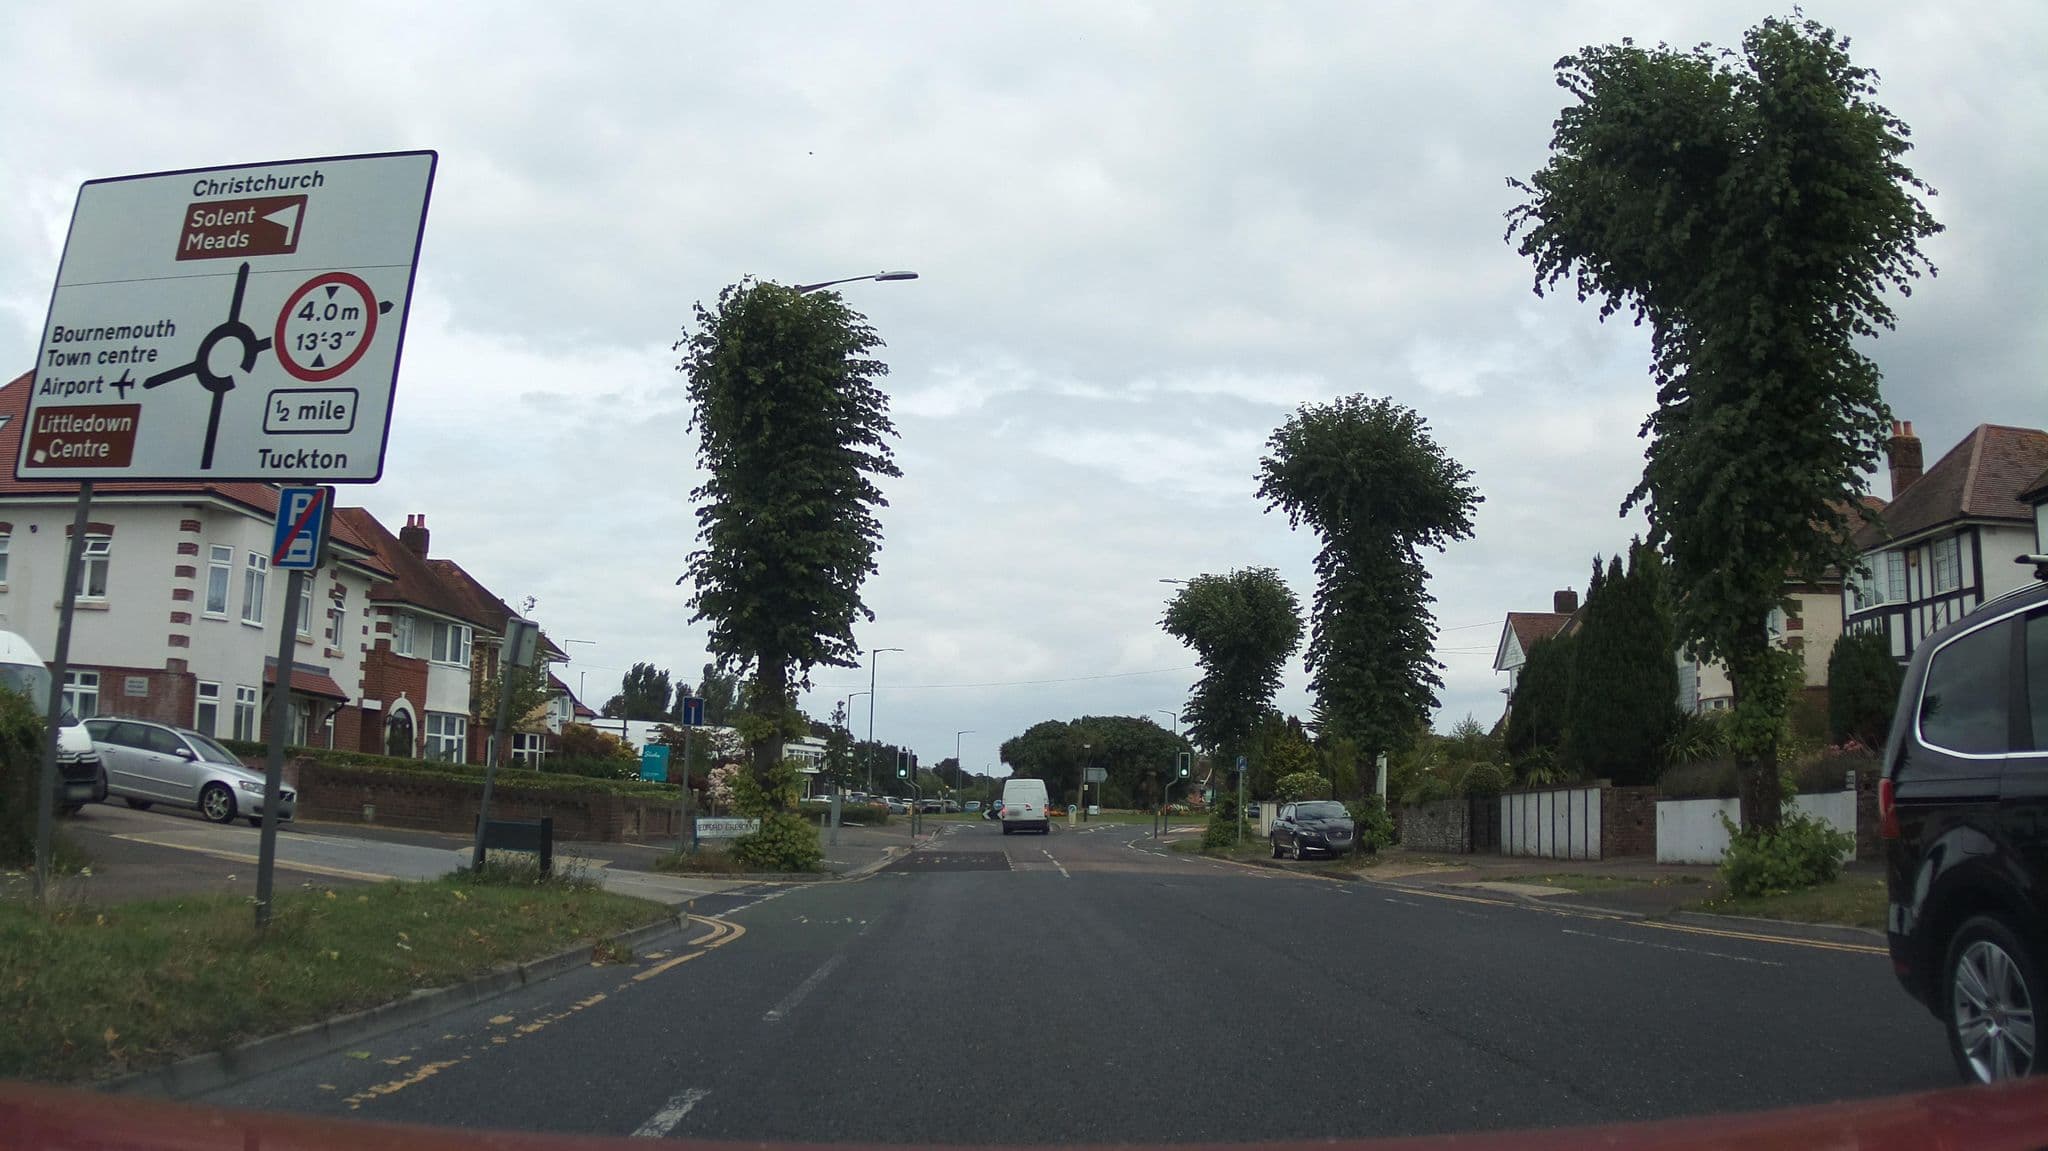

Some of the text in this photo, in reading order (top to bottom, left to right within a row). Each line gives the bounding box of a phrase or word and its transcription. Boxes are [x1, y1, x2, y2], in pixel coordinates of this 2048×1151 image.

[193, 170, 325, 197] Christchurch
[191, 206, 256, 228] Solent
[185, 230, 250, 251] Meads
[52, 319, 176, 344] Bournemouth
[47, 345, 158, 367] Town centre
[39, 375, 104, 398] Airport
[298, 400, 346, 420] mile
[38, 414, 132, 434] Littledown
[50, 438, 110, 458] Centre
[258, 449, 348, 469] Tuckton
[288, 493, 314, 527] P
